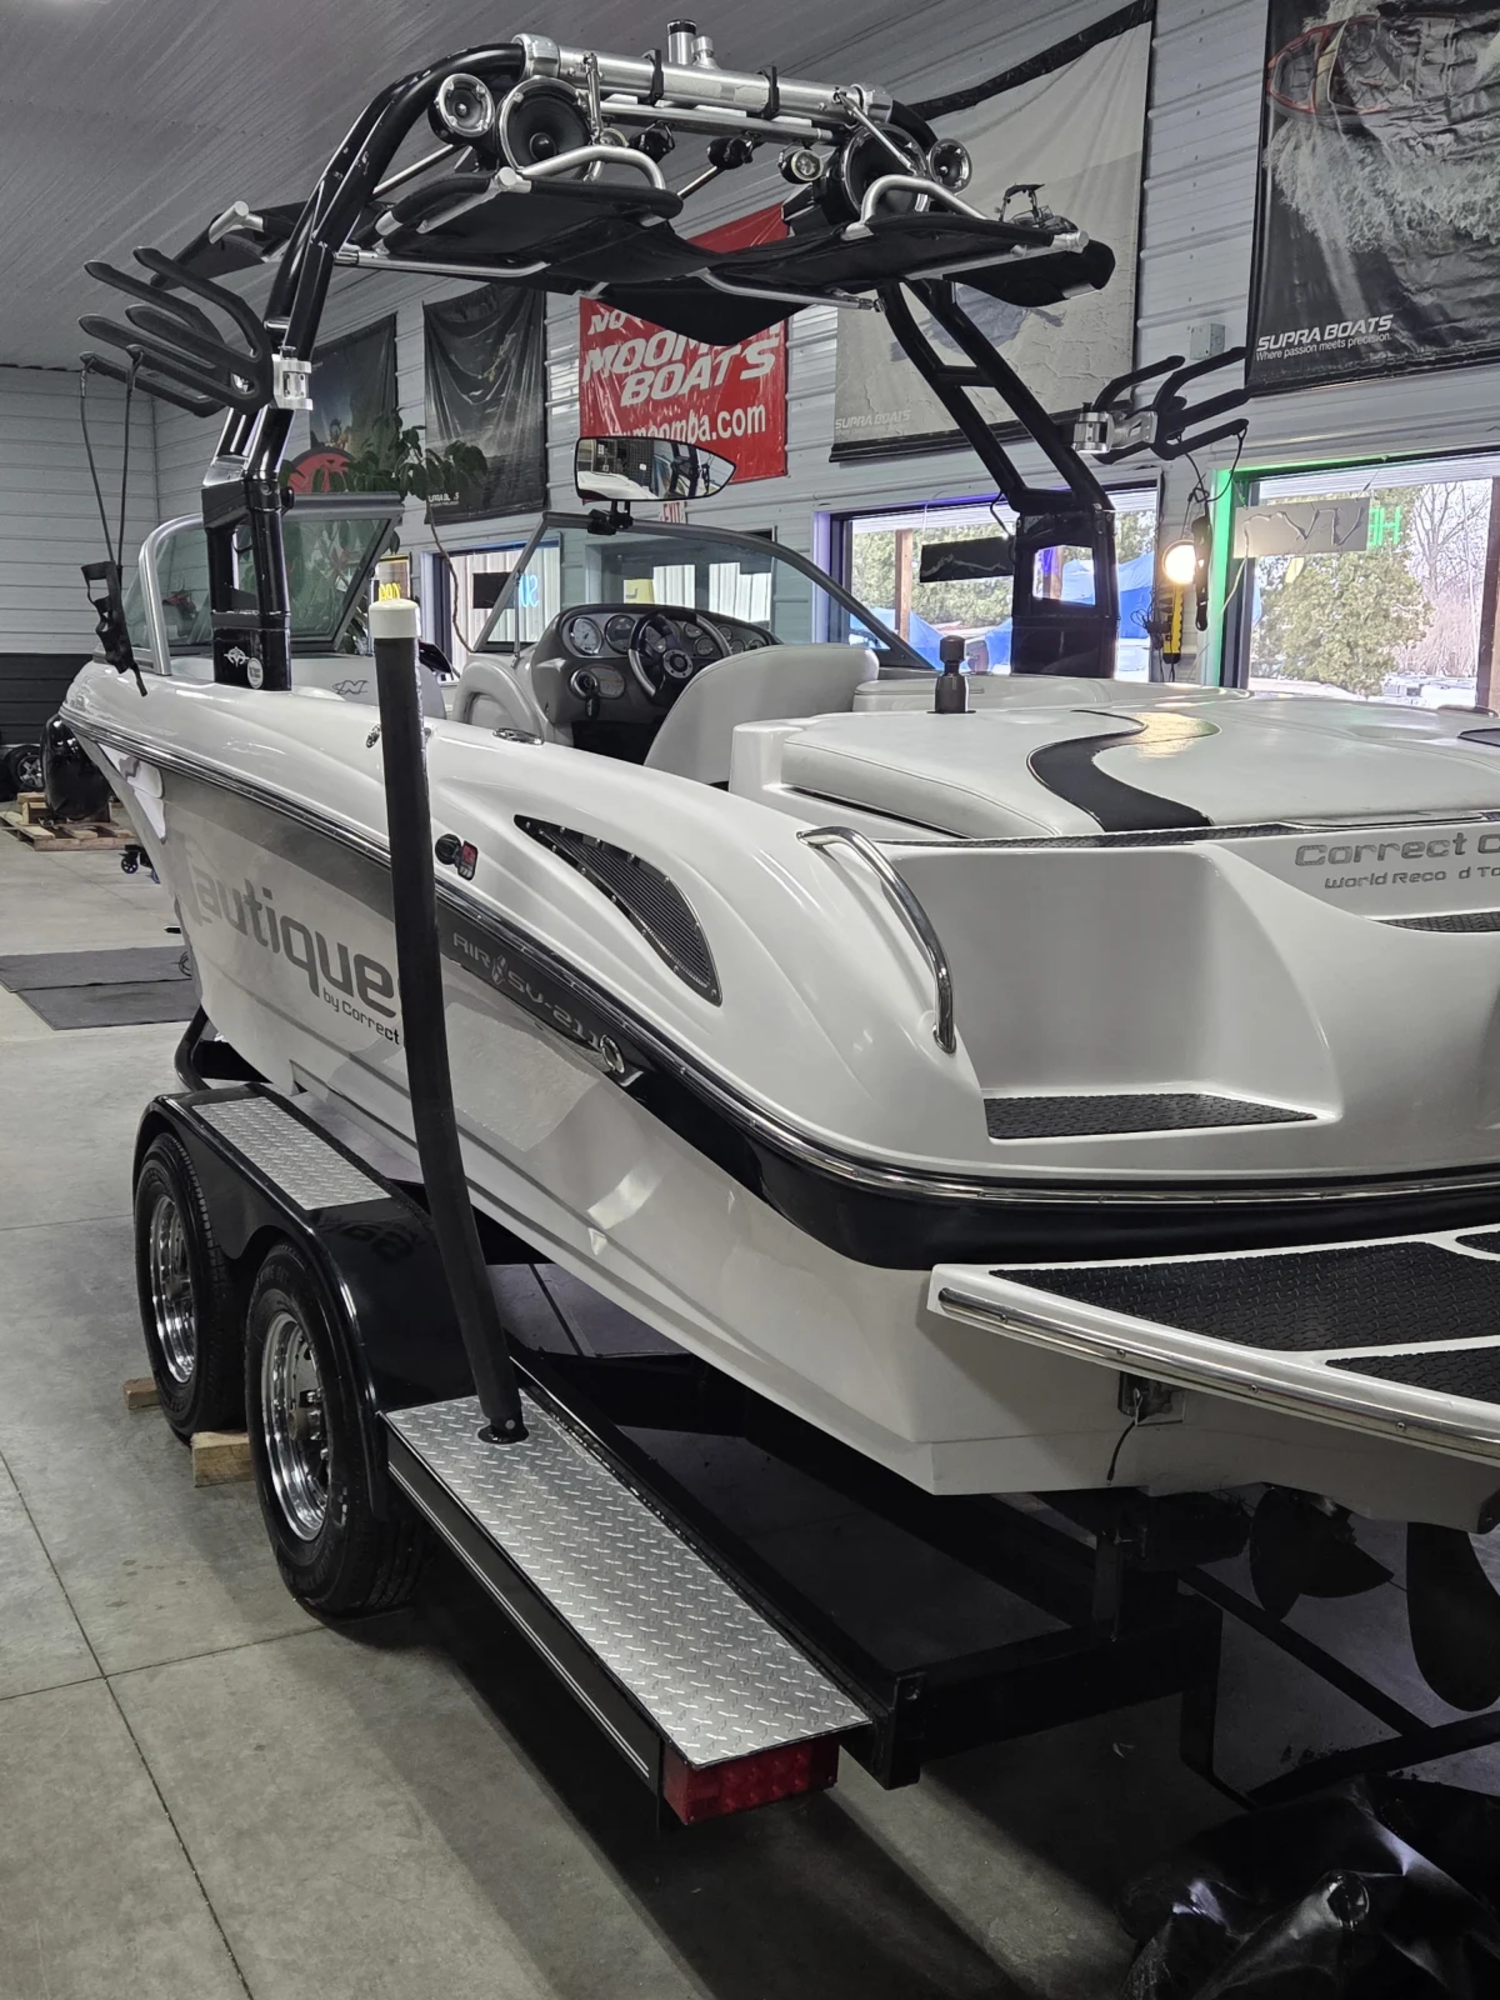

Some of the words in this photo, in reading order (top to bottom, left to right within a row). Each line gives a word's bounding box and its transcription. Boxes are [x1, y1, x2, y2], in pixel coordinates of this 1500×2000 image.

[1256, 350, 1283, 361] Where
[1284, 344, 1317, 359] passion
[1319, 338, 1346, 352] meets
[1257, 327, 1321, 352] SUPRA
[1323, 314, 1394, 341] BOATS
[583, 326, 781, 384] MOOM
[620, 336, 780, 407] BOATS
[835, 414, 873, 430] SUPRA
[1294, 832, 1468, 867] Correct
[1324, 872, 1388, 889] World
[454, 933, 491, 968] AIR
[323, 986, 340, 1013] by
[342, 1002, 400, 1045] Correct
